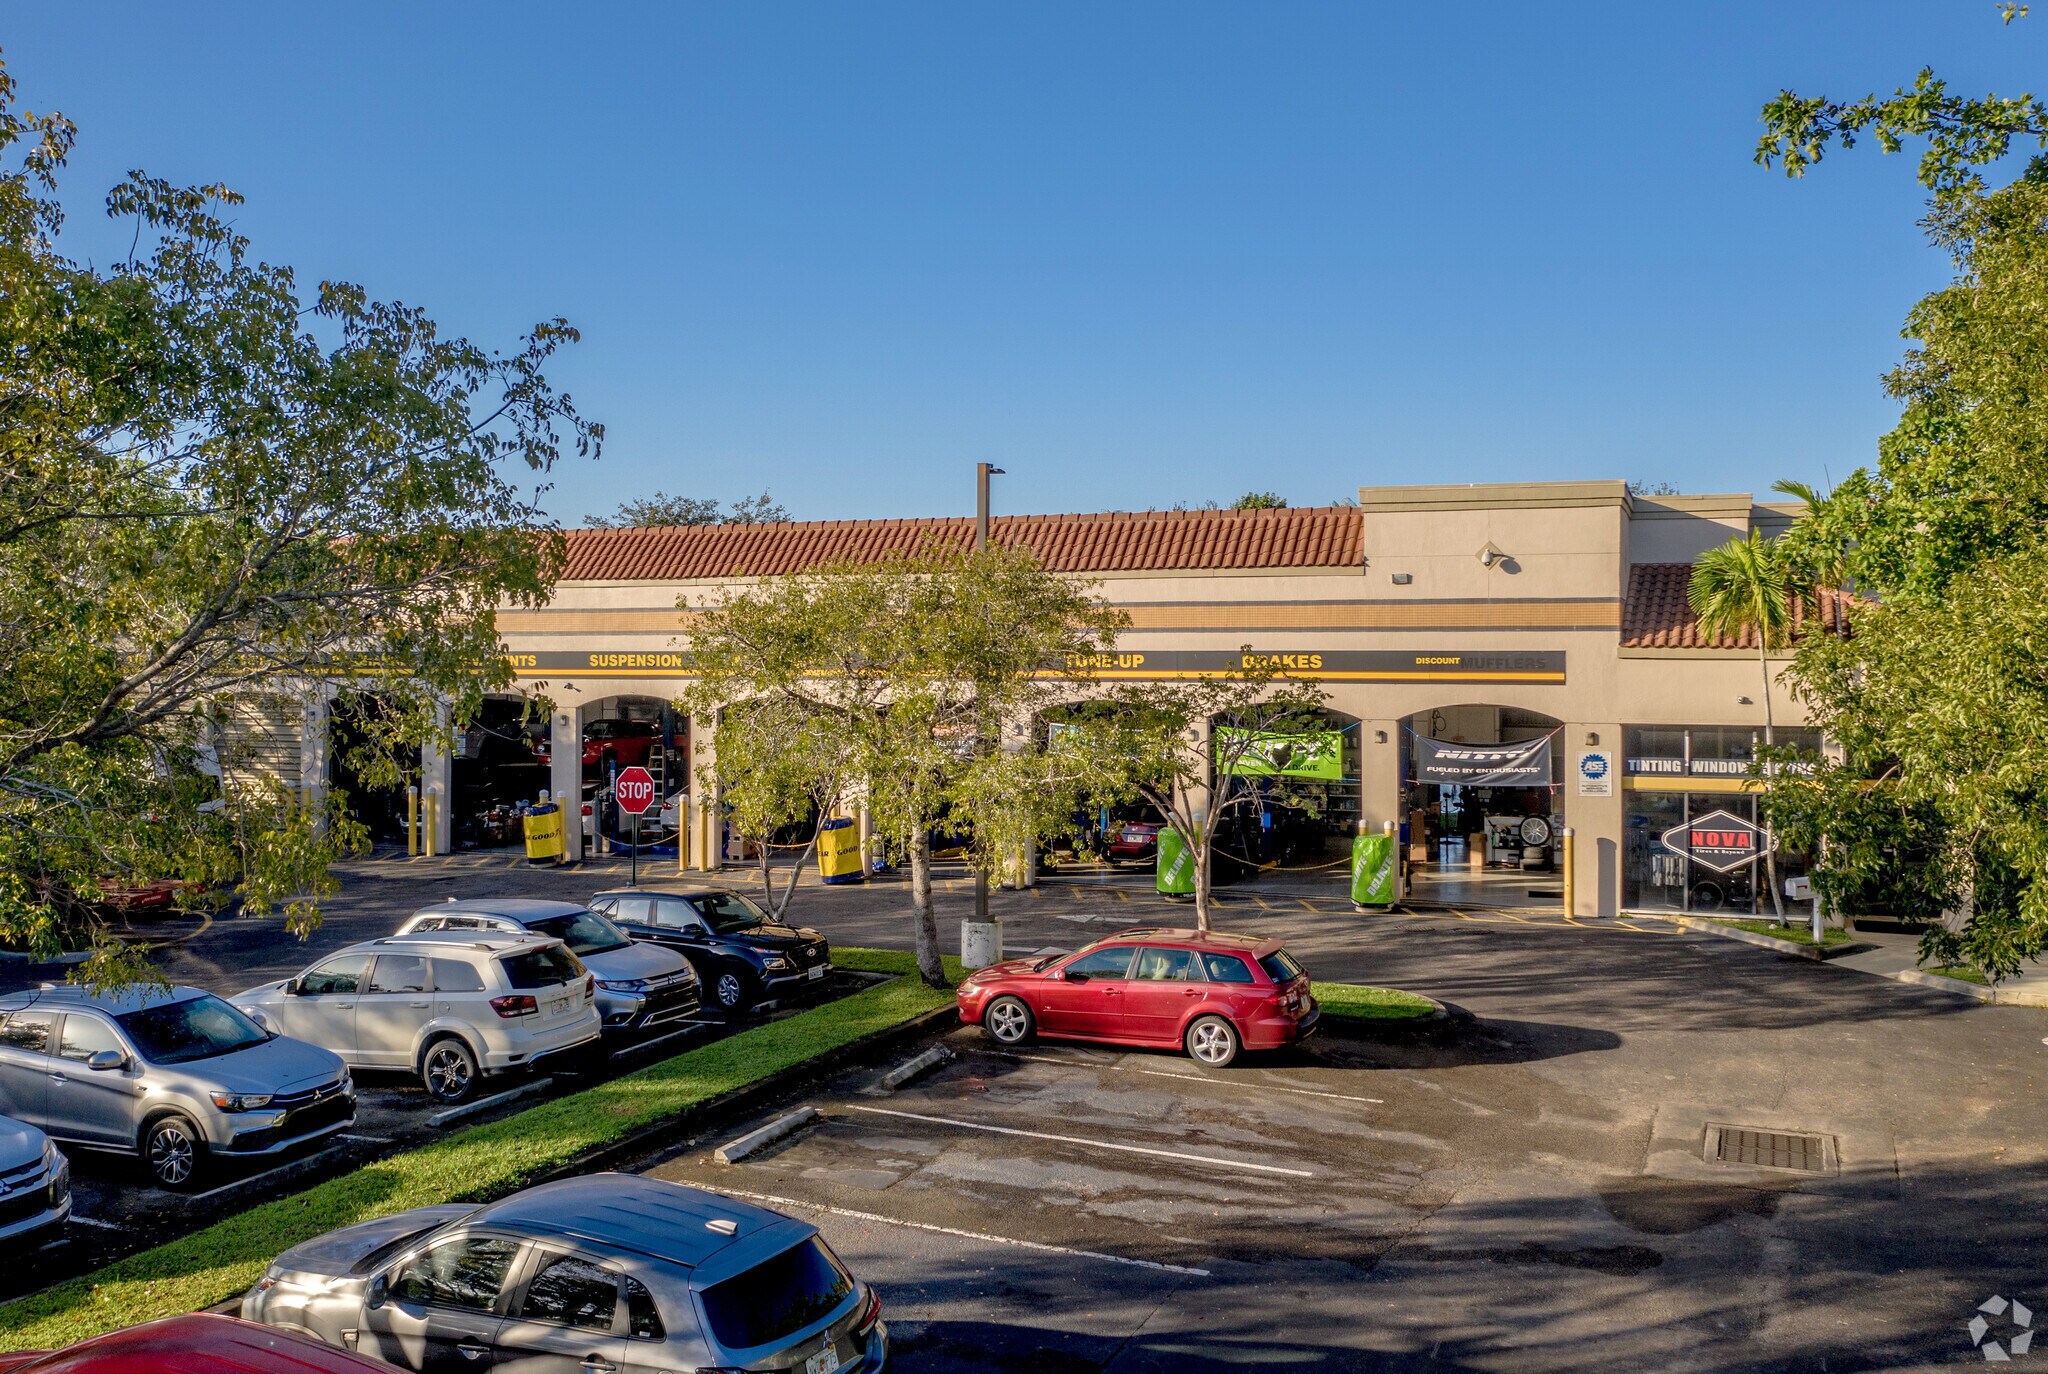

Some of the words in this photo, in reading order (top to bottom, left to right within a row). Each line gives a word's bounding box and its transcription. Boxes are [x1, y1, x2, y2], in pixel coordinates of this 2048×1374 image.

[589, 654, 682, 667] SUSPENSION
[1064, 654, 1145, 668] TUNE-UP
[1415, 657, 1460, 665] DISCOUNT
[1460, 657, 1546, 669] MUFFLERS
[1434, 748, 1531, 760] NITTO
[1584, 761, 1604, 771] ASE
[1628, 759, 1681, 772] TINTING
[619, 781, 652, 799] STOP
[1691, 831, 1750, 847] NOVA
[1164, 847, 1190, 886] DELINTE
[1367, 855, 1393, 897] DELINTE
